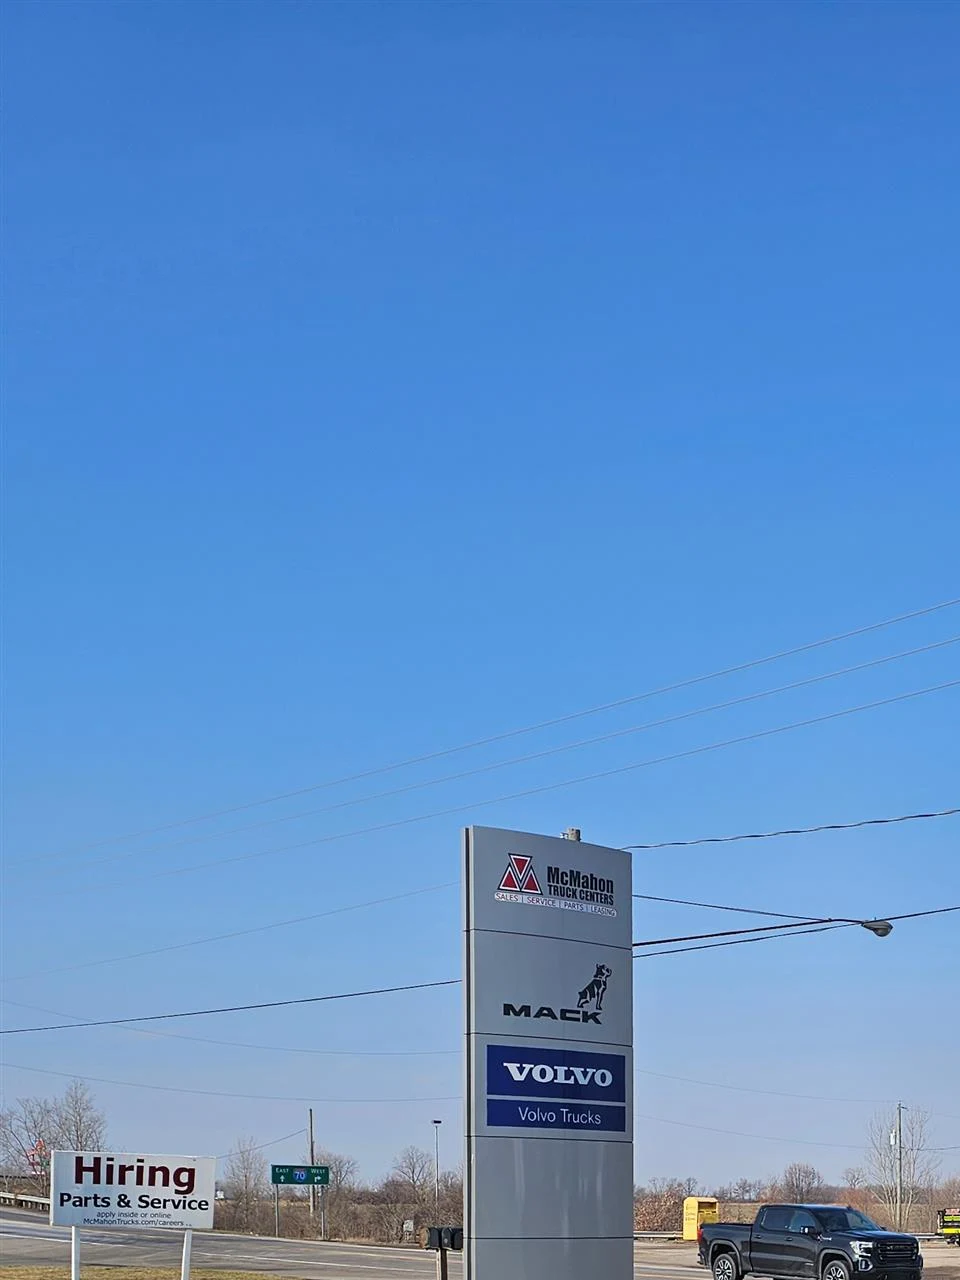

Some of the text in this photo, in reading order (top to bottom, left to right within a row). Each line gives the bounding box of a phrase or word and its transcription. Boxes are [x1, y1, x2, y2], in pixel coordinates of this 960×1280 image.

[547, 866, 614, 894] McMahon
[495, 893, 519, 902] SALES
[527, 897, 556, 907] SERVICE
[564, 901, 584, 911] PARTS
[547, 884, 614, 906] TRUCK CENTERS
[503, 1003, 602, 1025] MACK
[503, 1062, 612, 1087] VOLVO
[518, 1106, 601, 1126] Volvo Trucks
[74, 1156, 196, 1196] Hiring
[295, 1171, 305, 1180] 70
[59, 1192, 209, 1211] Parts & Service
[83, 1218, 184, 1227] McMahonTrucks.com/careers
[96, 1211, 116, 1219] apply
[150, 1211, 172, 1219] online
